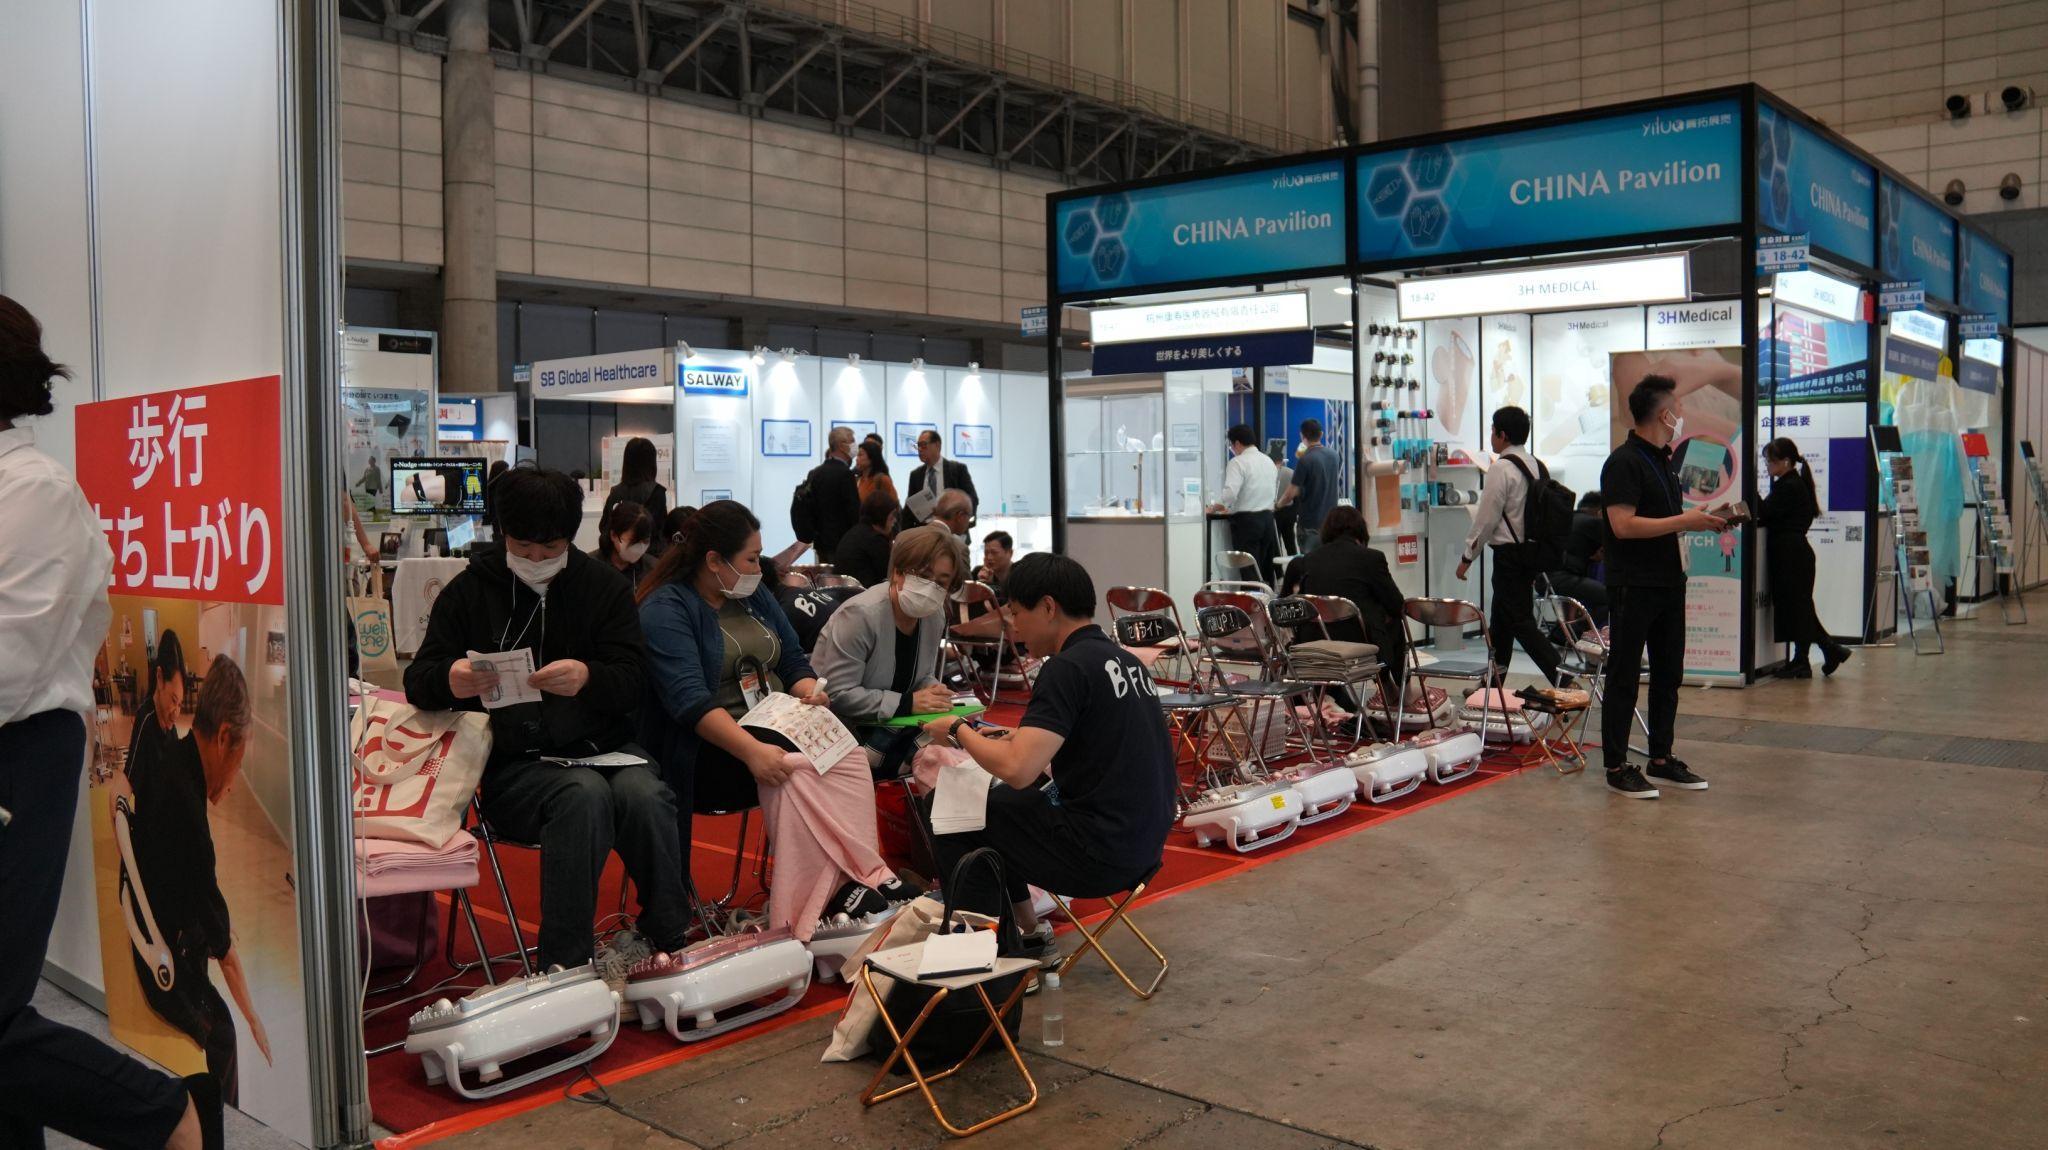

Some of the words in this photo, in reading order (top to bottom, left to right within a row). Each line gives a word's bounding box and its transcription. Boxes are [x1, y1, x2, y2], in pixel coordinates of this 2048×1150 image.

[1509, 169, 1610, 205] CHINA
[1619, 160, 1720, 191] Pavilion
[1810, 182, 1841, 219] CHINA
[1842, 201, 1869, 231] Pavilion
[1173, 216, 1249, 246] CHINA
[1255, 210, 1332, 236] Pavilion
[1774, 250, 1805, 262] 18-42
[1518, 284, 1534, 296] 3H
[1539, 280, 1598, 295] MEDICAL
[1156, 346, 1242, 361] 世界をより美しくする
[540, 371, 555, 387] SB
[558, 367, 591, 385] Global
[594, 363, 657, 382] Healthcare
[686, 372, 741, 387] SALWAY
[1761, 415, 1811, 428] 企業概要
[128, 394, 208, 490] 歩行
[1686, 535, 1714, 547] TCH
[1127, 620, 1162, 639] セライト
